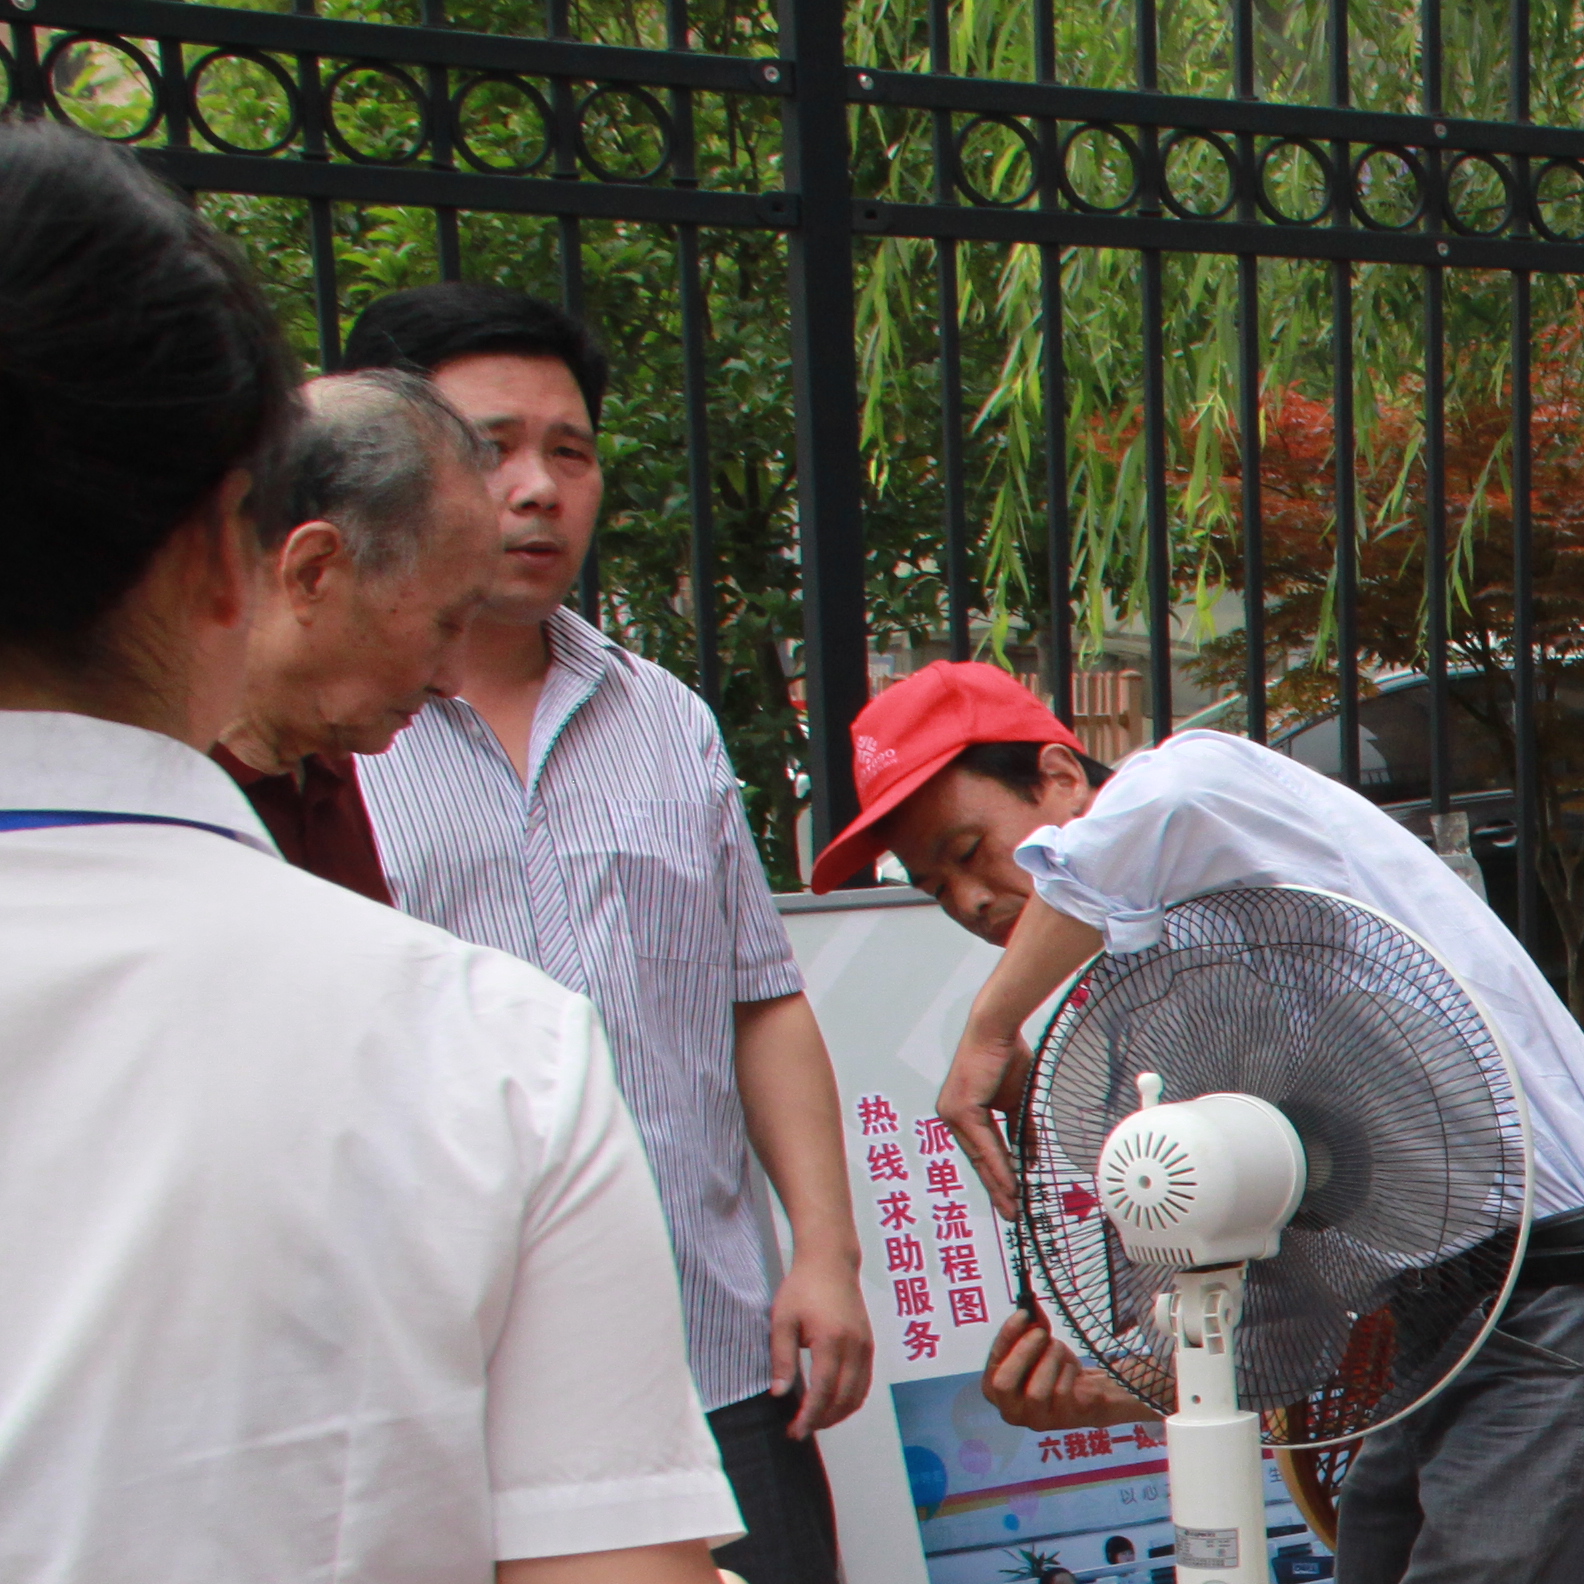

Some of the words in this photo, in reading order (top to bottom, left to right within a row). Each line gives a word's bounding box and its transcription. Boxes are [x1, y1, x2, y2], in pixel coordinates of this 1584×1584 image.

[857, 1095, 941, 1361] 热线求助服务
[914, 1117, 989, 1327] 派单流程图
